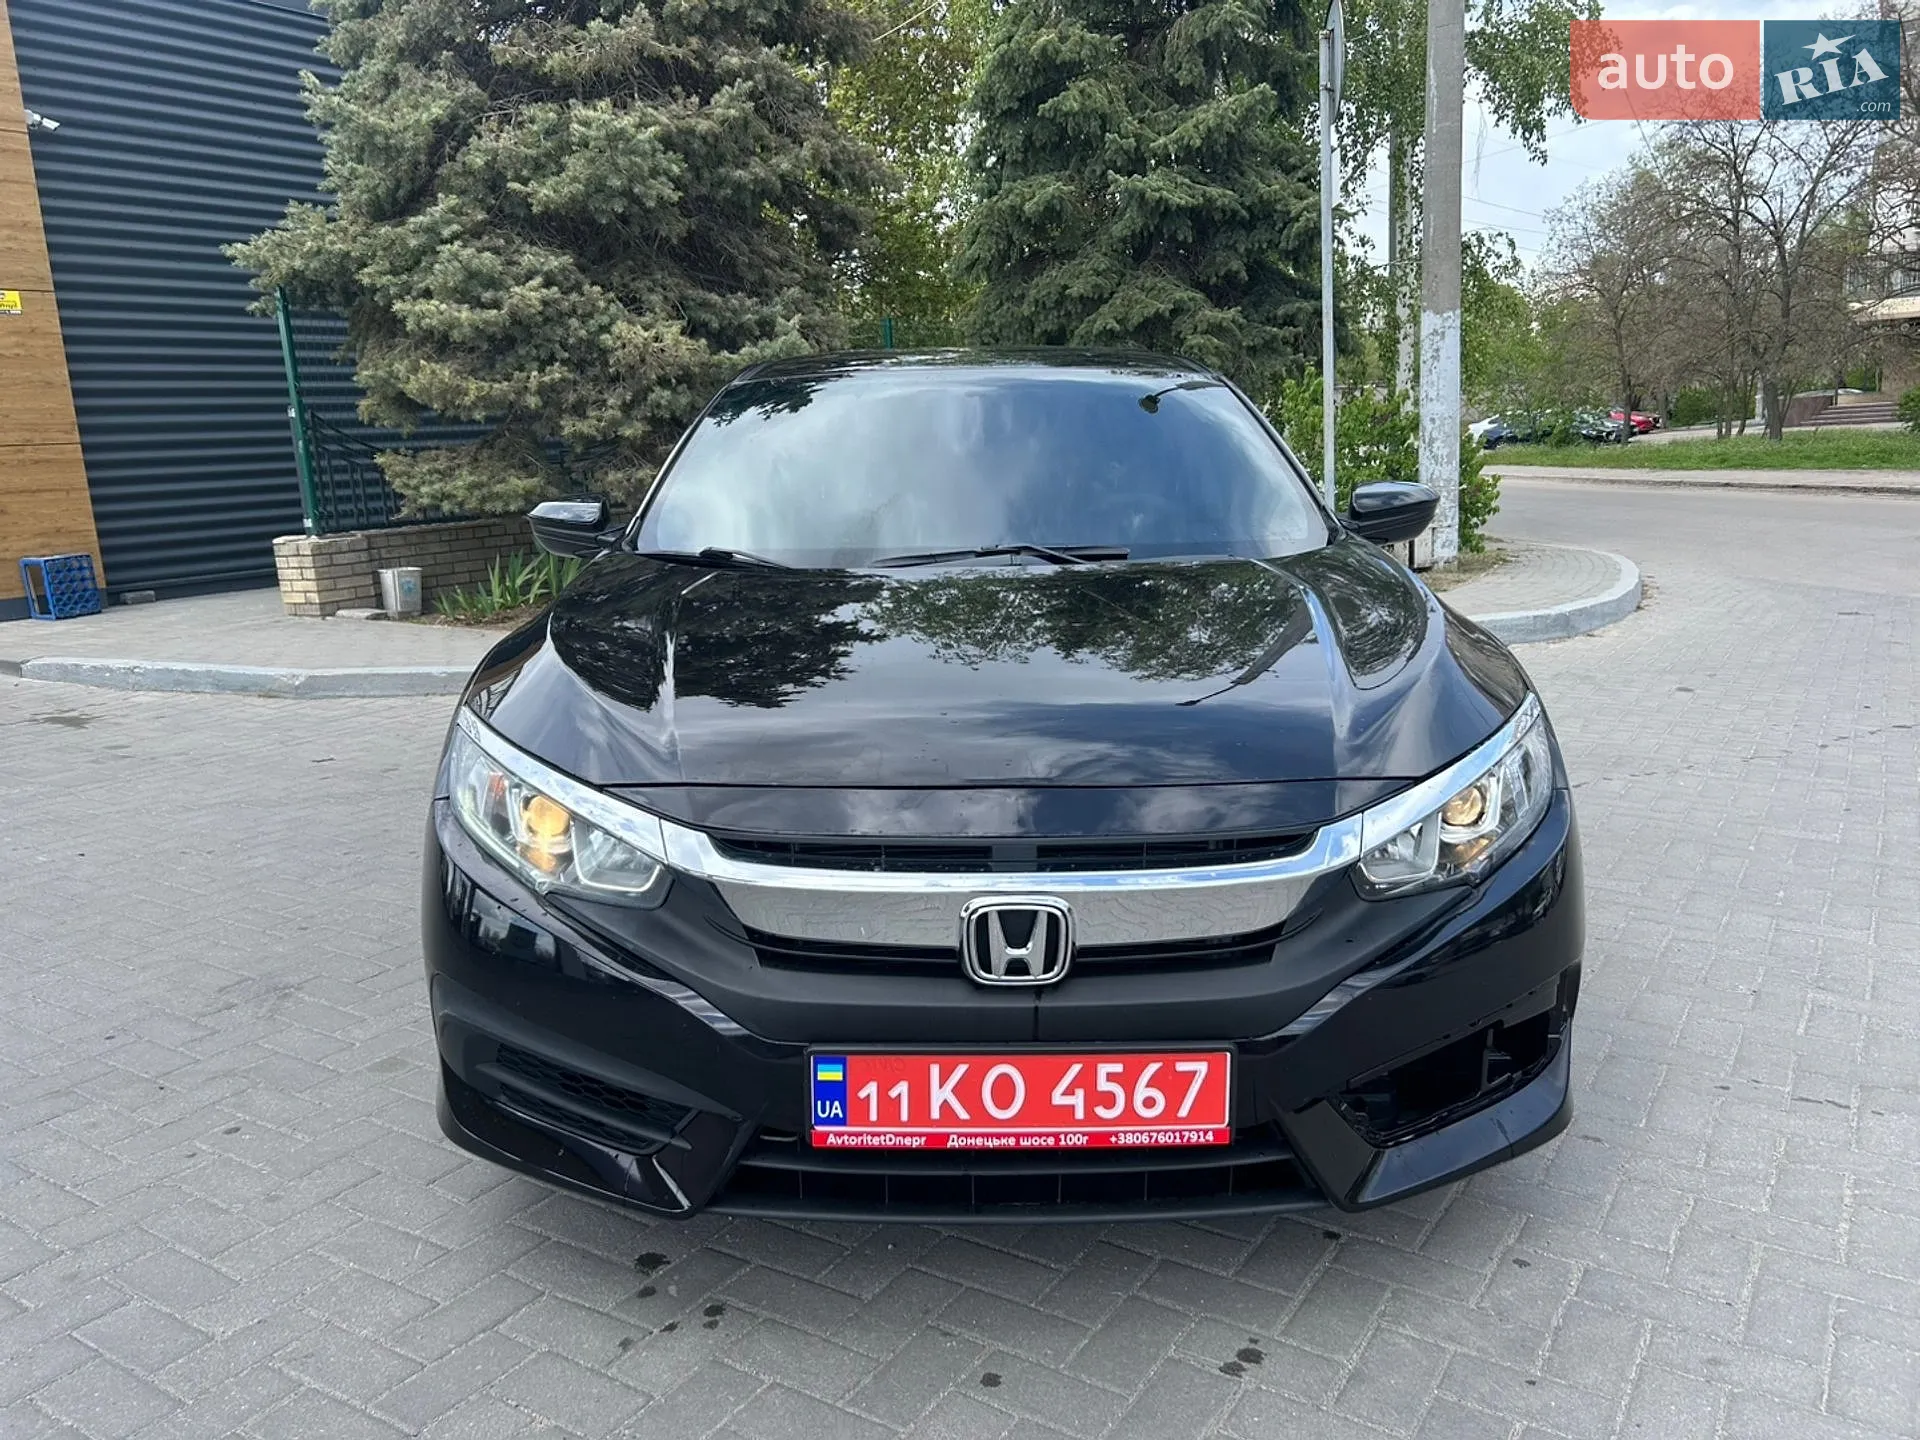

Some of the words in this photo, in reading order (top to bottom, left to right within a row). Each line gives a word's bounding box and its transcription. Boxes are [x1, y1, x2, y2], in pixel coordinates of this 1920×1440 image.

[1051, 1061, 1209, 1120] 4567
[817, 1100, 843, 1118] UA
[826, 1133, 927, 1148] AvtoritetDnepr
[946, 1133, 1016, 1149] Донецьке
[1019, 1135, 1055, 1146] шосе
[1058, 1132, 1089, 1146] 100г
[1109, 1130, 1214, 1145] +380676017914
